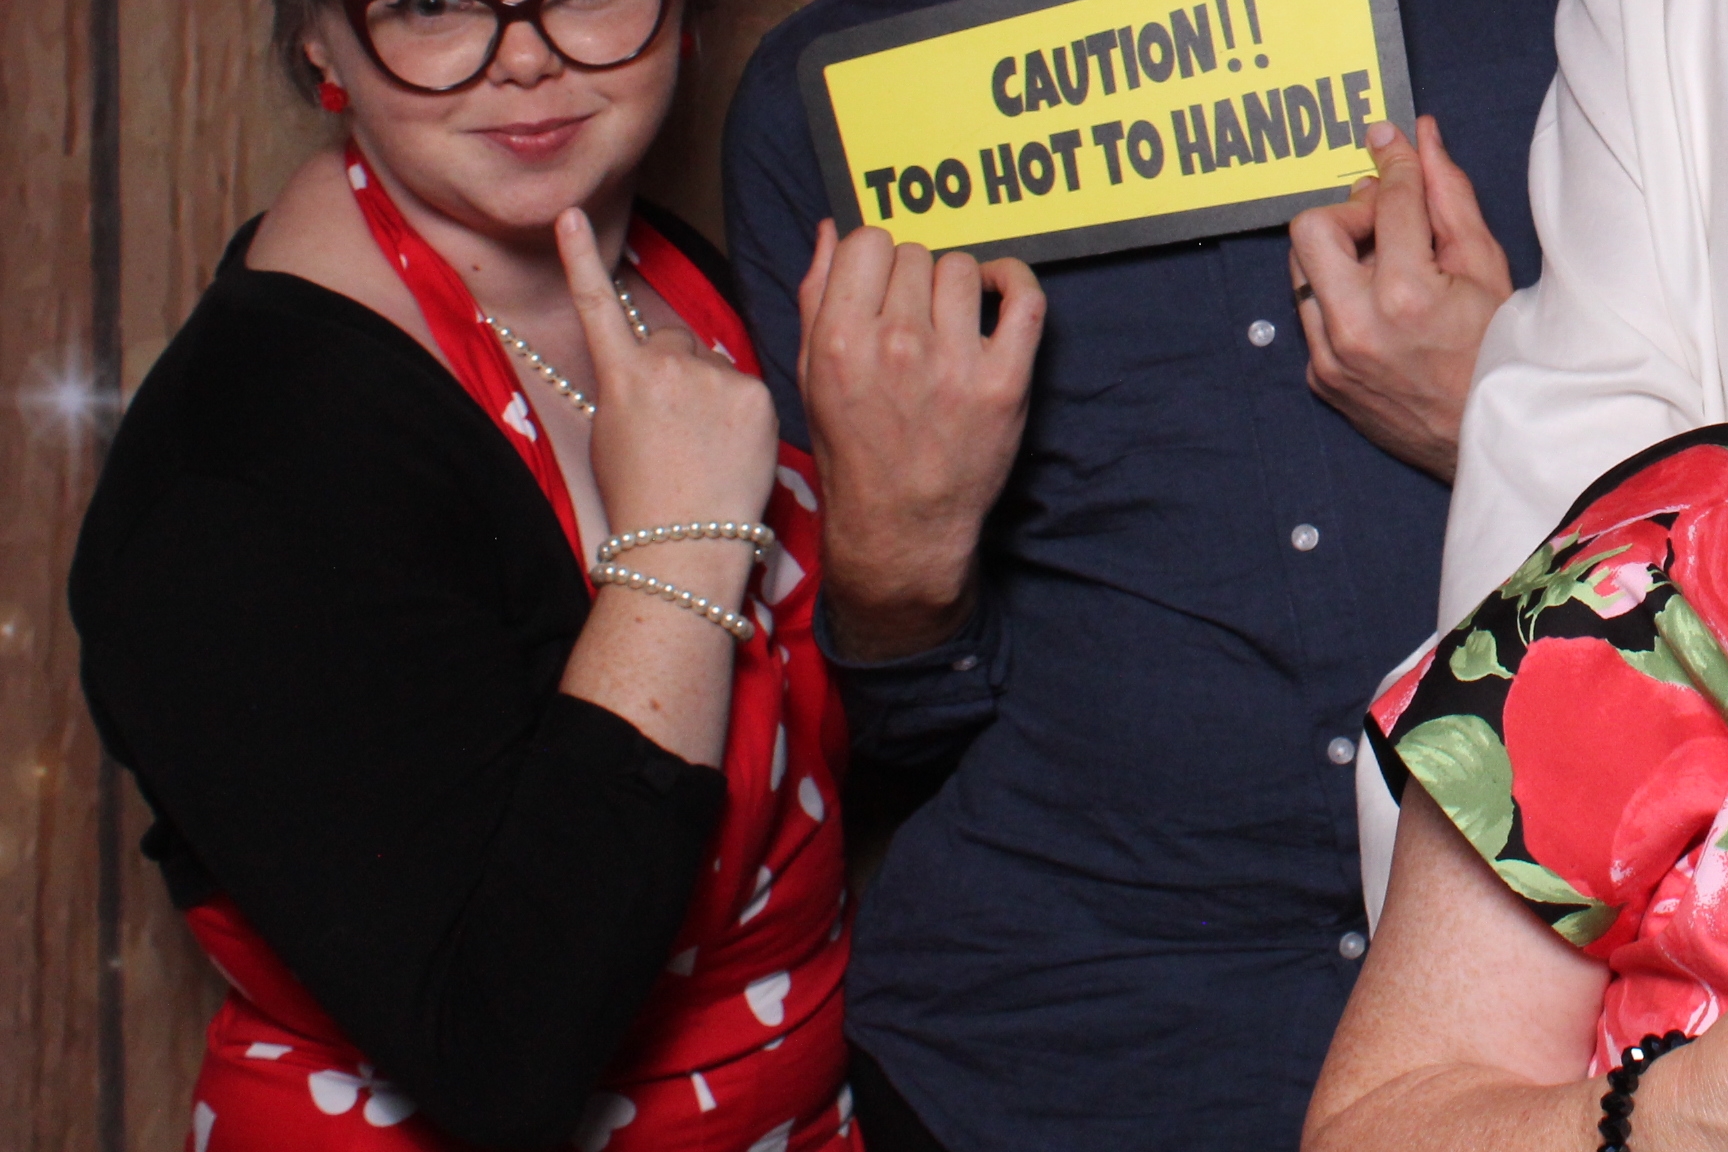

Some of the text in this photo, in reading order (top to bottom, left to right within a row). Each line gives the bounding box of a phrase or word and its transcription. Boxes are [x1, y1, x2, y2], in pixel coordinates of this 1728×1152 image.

[864, 69, 1372, 221] TOO HOT TO HANDLE
